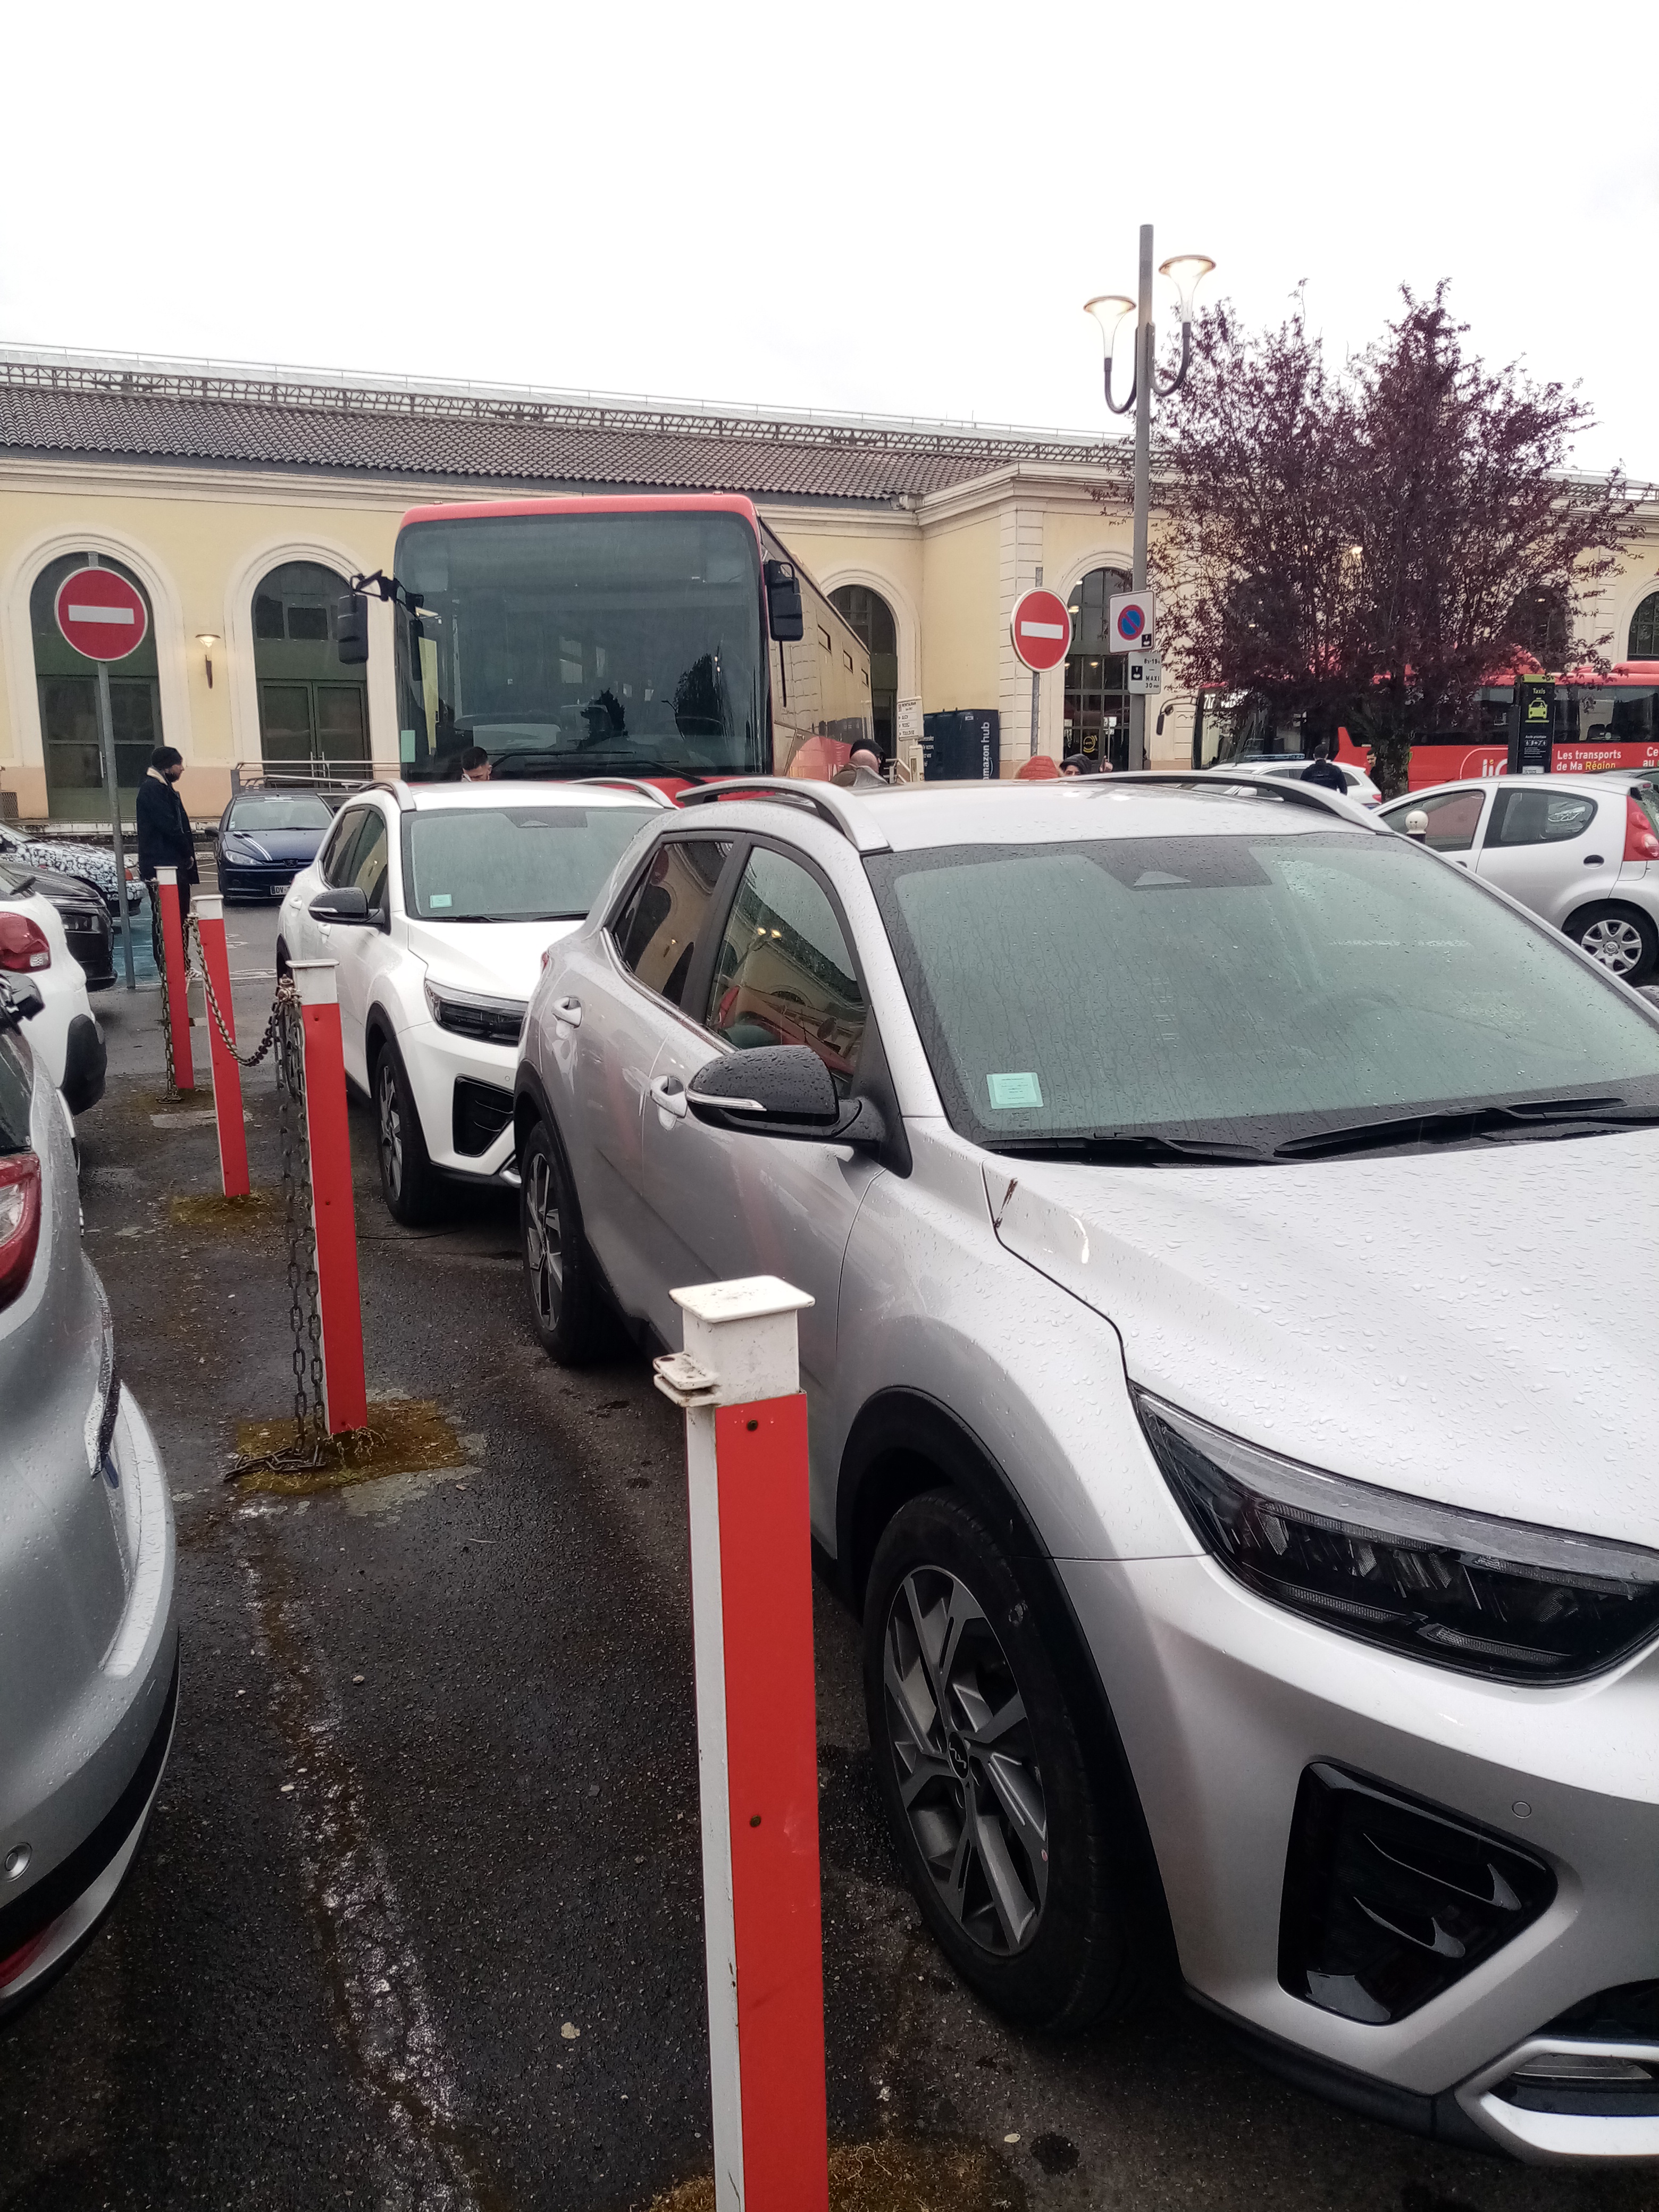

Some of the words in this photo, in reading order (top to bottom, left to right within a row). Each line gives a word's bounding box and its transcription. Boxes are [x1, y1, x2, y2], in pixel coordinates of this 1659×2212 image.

[980, 722, 990, 743] hub
[1557, 750, 1573, 760] Les
[1575, 749, 1622, 761] transports
[1556, 761, 1568, 771] de
[1570, 761, 1582, 771] Ma
[1585, 760, 1616, 770] Région
